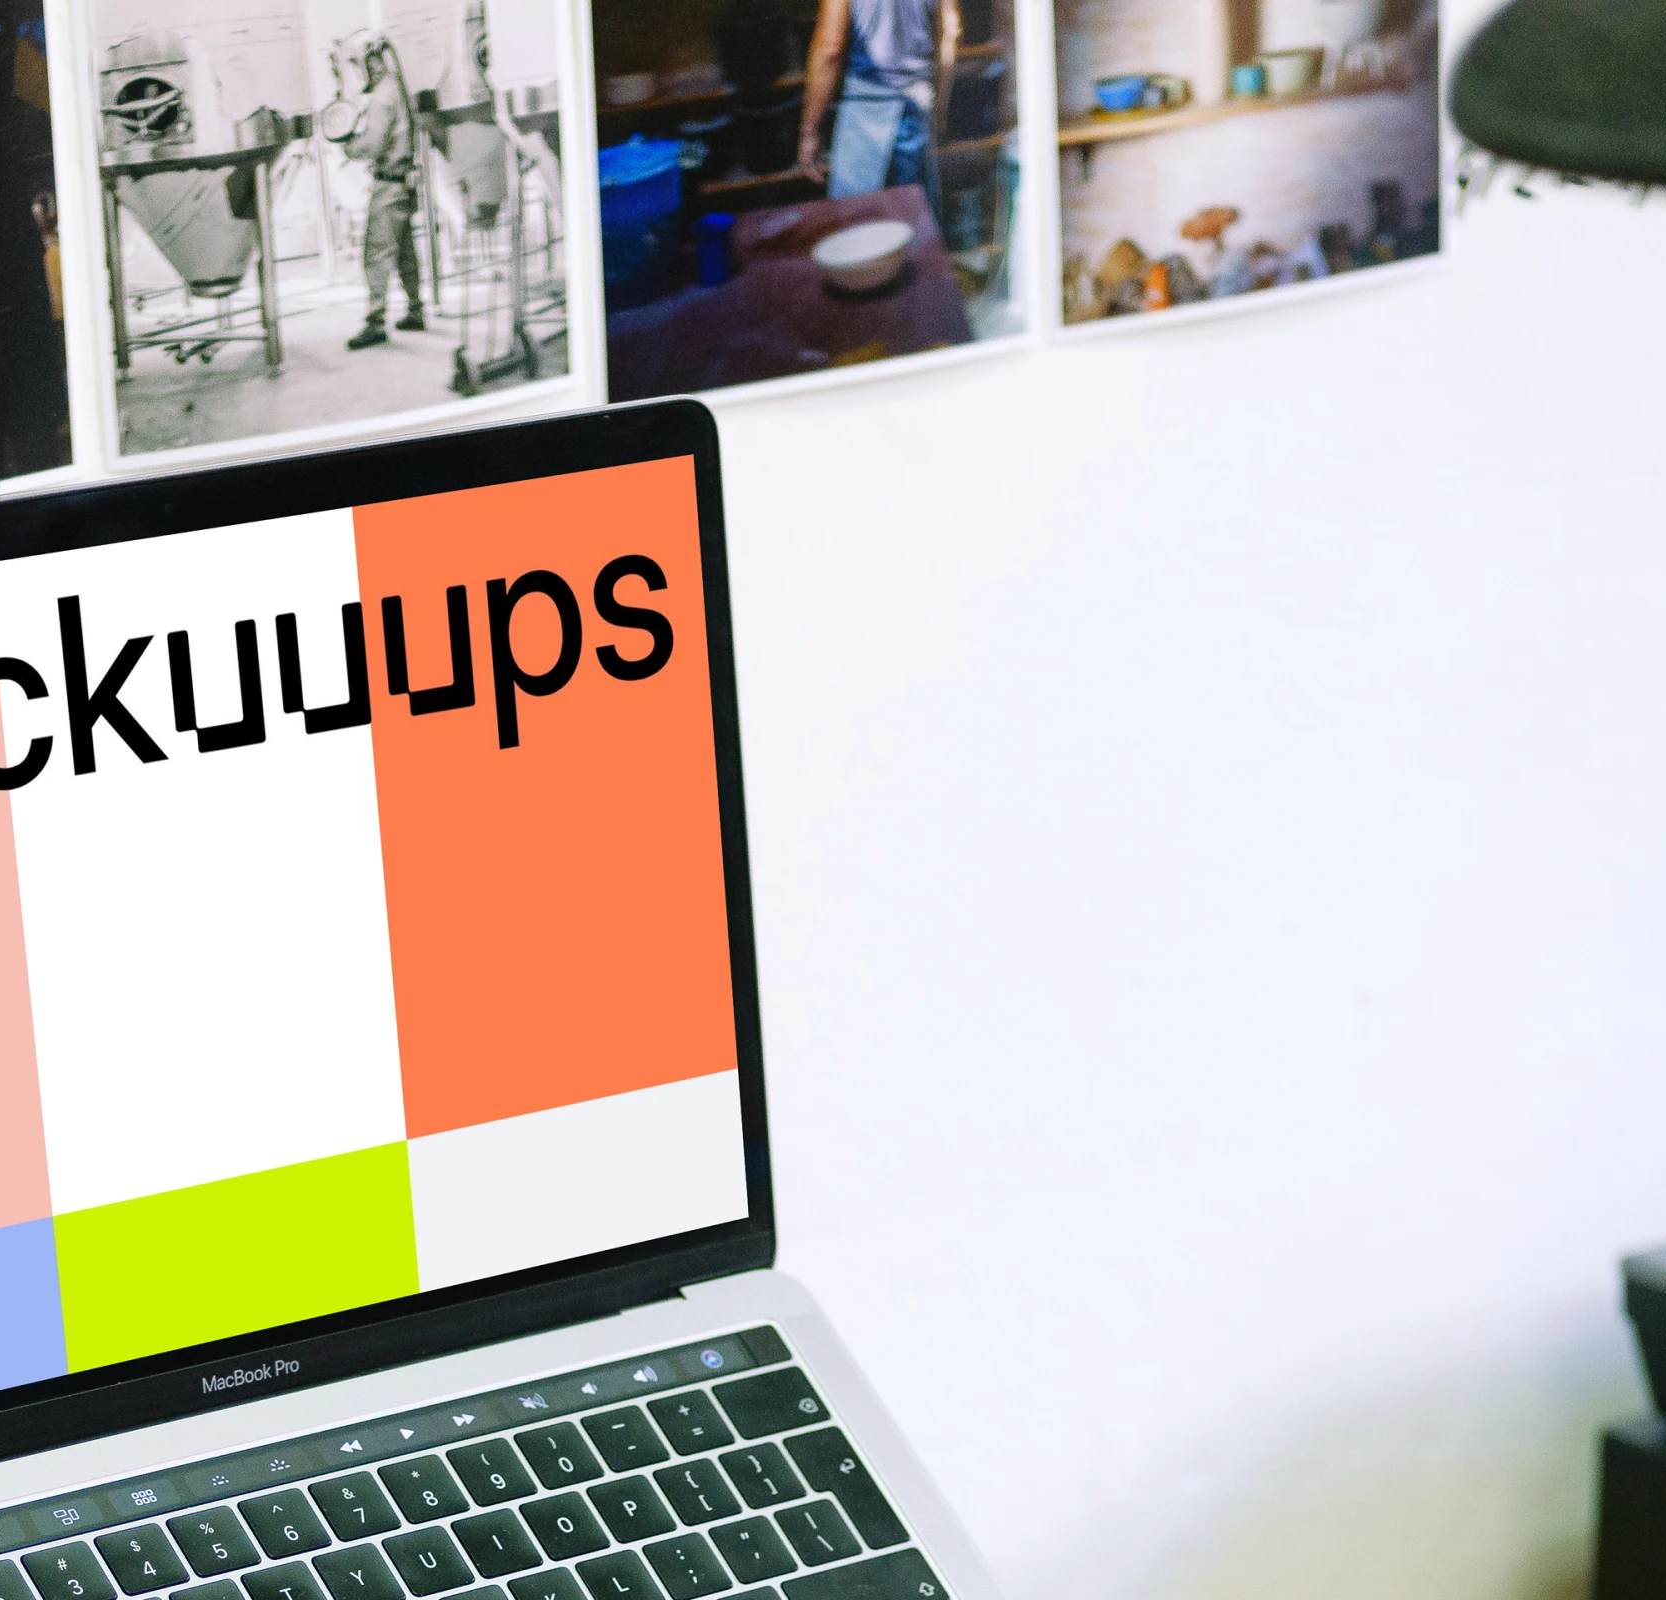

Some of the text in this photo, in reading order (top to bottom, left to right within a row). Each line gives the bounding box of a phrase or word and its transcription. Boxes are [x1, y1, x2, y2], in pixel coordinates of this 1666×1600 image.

[201, 1359, 300, 1394] MacBook Pro
[490, 1473, 506, 1490] 9
[422, 1490, 439, 1507] 8
[352, 1507, 365, 1524] 7
[622, 1500, 638, 1517] P
[283, 1525, 299, 1541] 6
[211, 1542, 228, 1559] 5
[143, 1560, 157, 1576] 4
[418, 1551, 437, 1569] U
[349, 1569, 365, 1586] Y
[612, 1577, 630, 1593] L
[67, 1579, 84, 1596] 3
